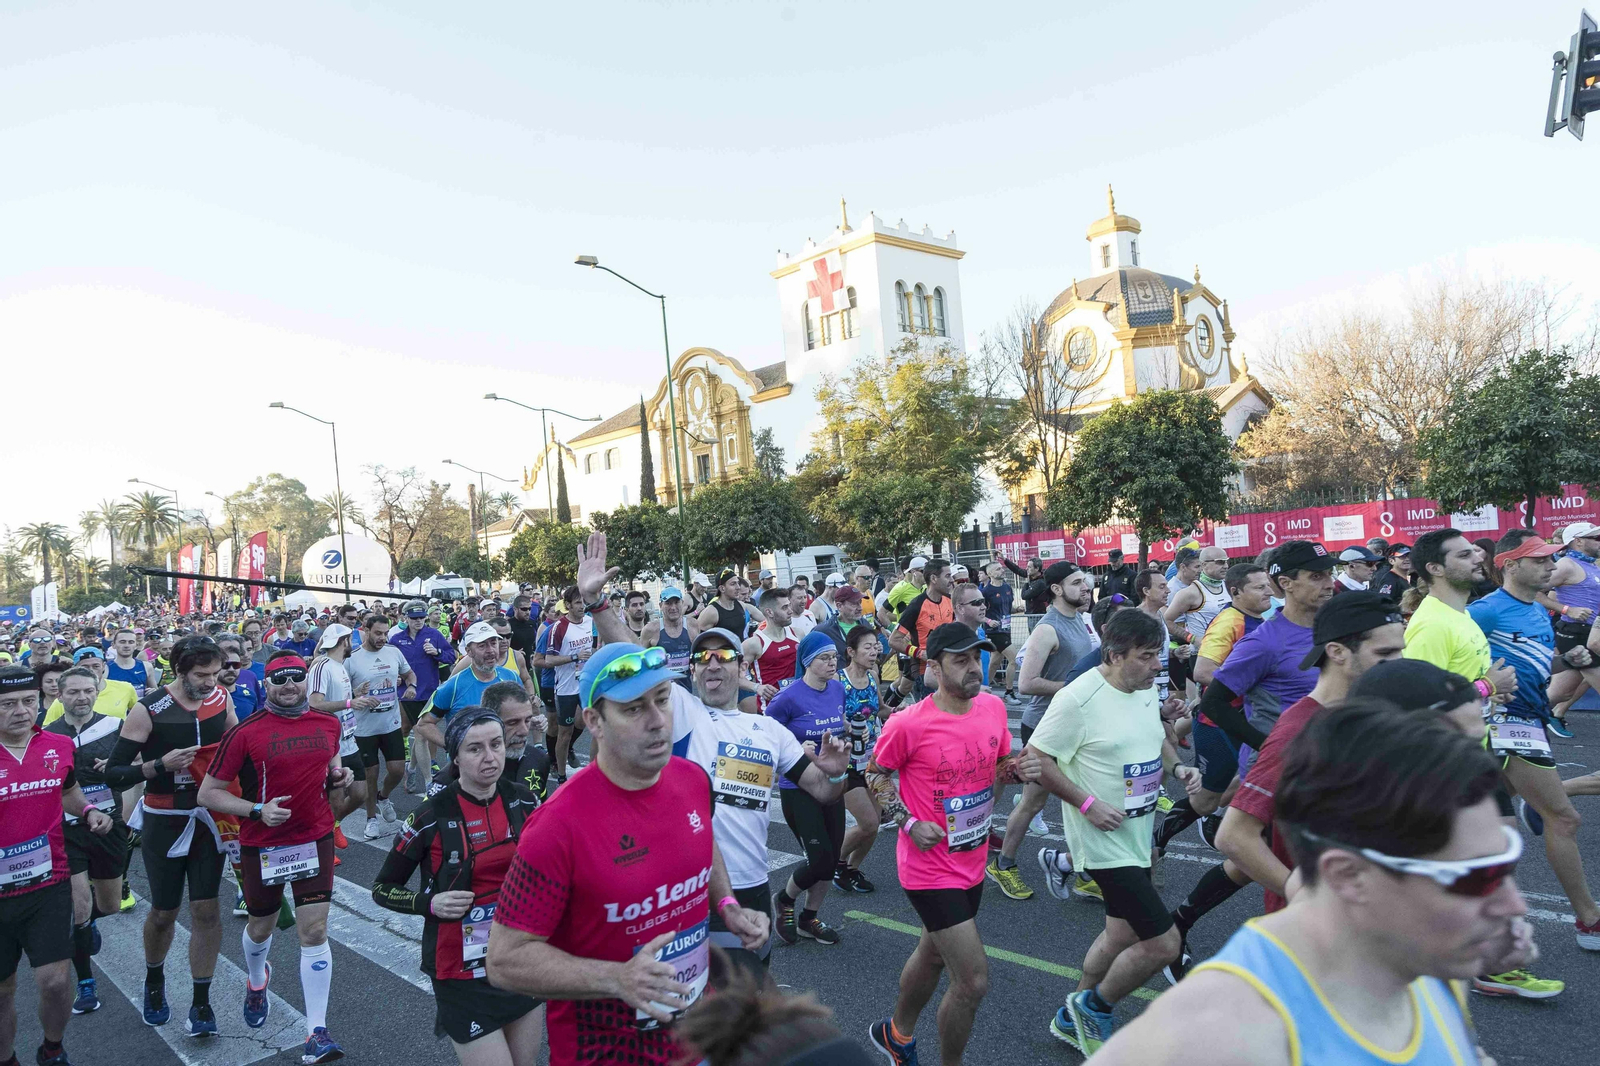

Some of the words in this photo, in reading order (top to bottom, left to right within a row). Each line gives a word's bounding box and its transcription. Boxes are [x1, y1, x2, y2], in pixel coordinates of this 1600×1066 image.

[1551, 496, 1585, 509] IMD
[1407, 508, 1435, 520] IMD
[1287, 518, 1311, 530] IMD
[1094, 535, 1112, 545] IMD
[815, 718, 830, 726] East
[739, 748, 773, 763] ZURICH
[736, 770, 760, 783] 5502
[10, 778, 61, 793] Lentos
[720, 782, 767, 798] BAMPYS4EVER
[964, 789, 992, 807] ZURICH
[951, 824, 976, 844] JODIDO
[8, 839, 43, 856] ZURICH
[9, 859, 35, 871] 8025
[279, 853, 301, 864] 8027
[274, 866, 289, 875] JOSE
[290, 862, 308, 872] MARI
[12, 871, 33, 880] DANA
[603, 896, 654, 923] Los
[626, 917, 655, 935] CLUB
[655, 912, 669, 926] DE
[665, 927, 706, 956] ZURICH
